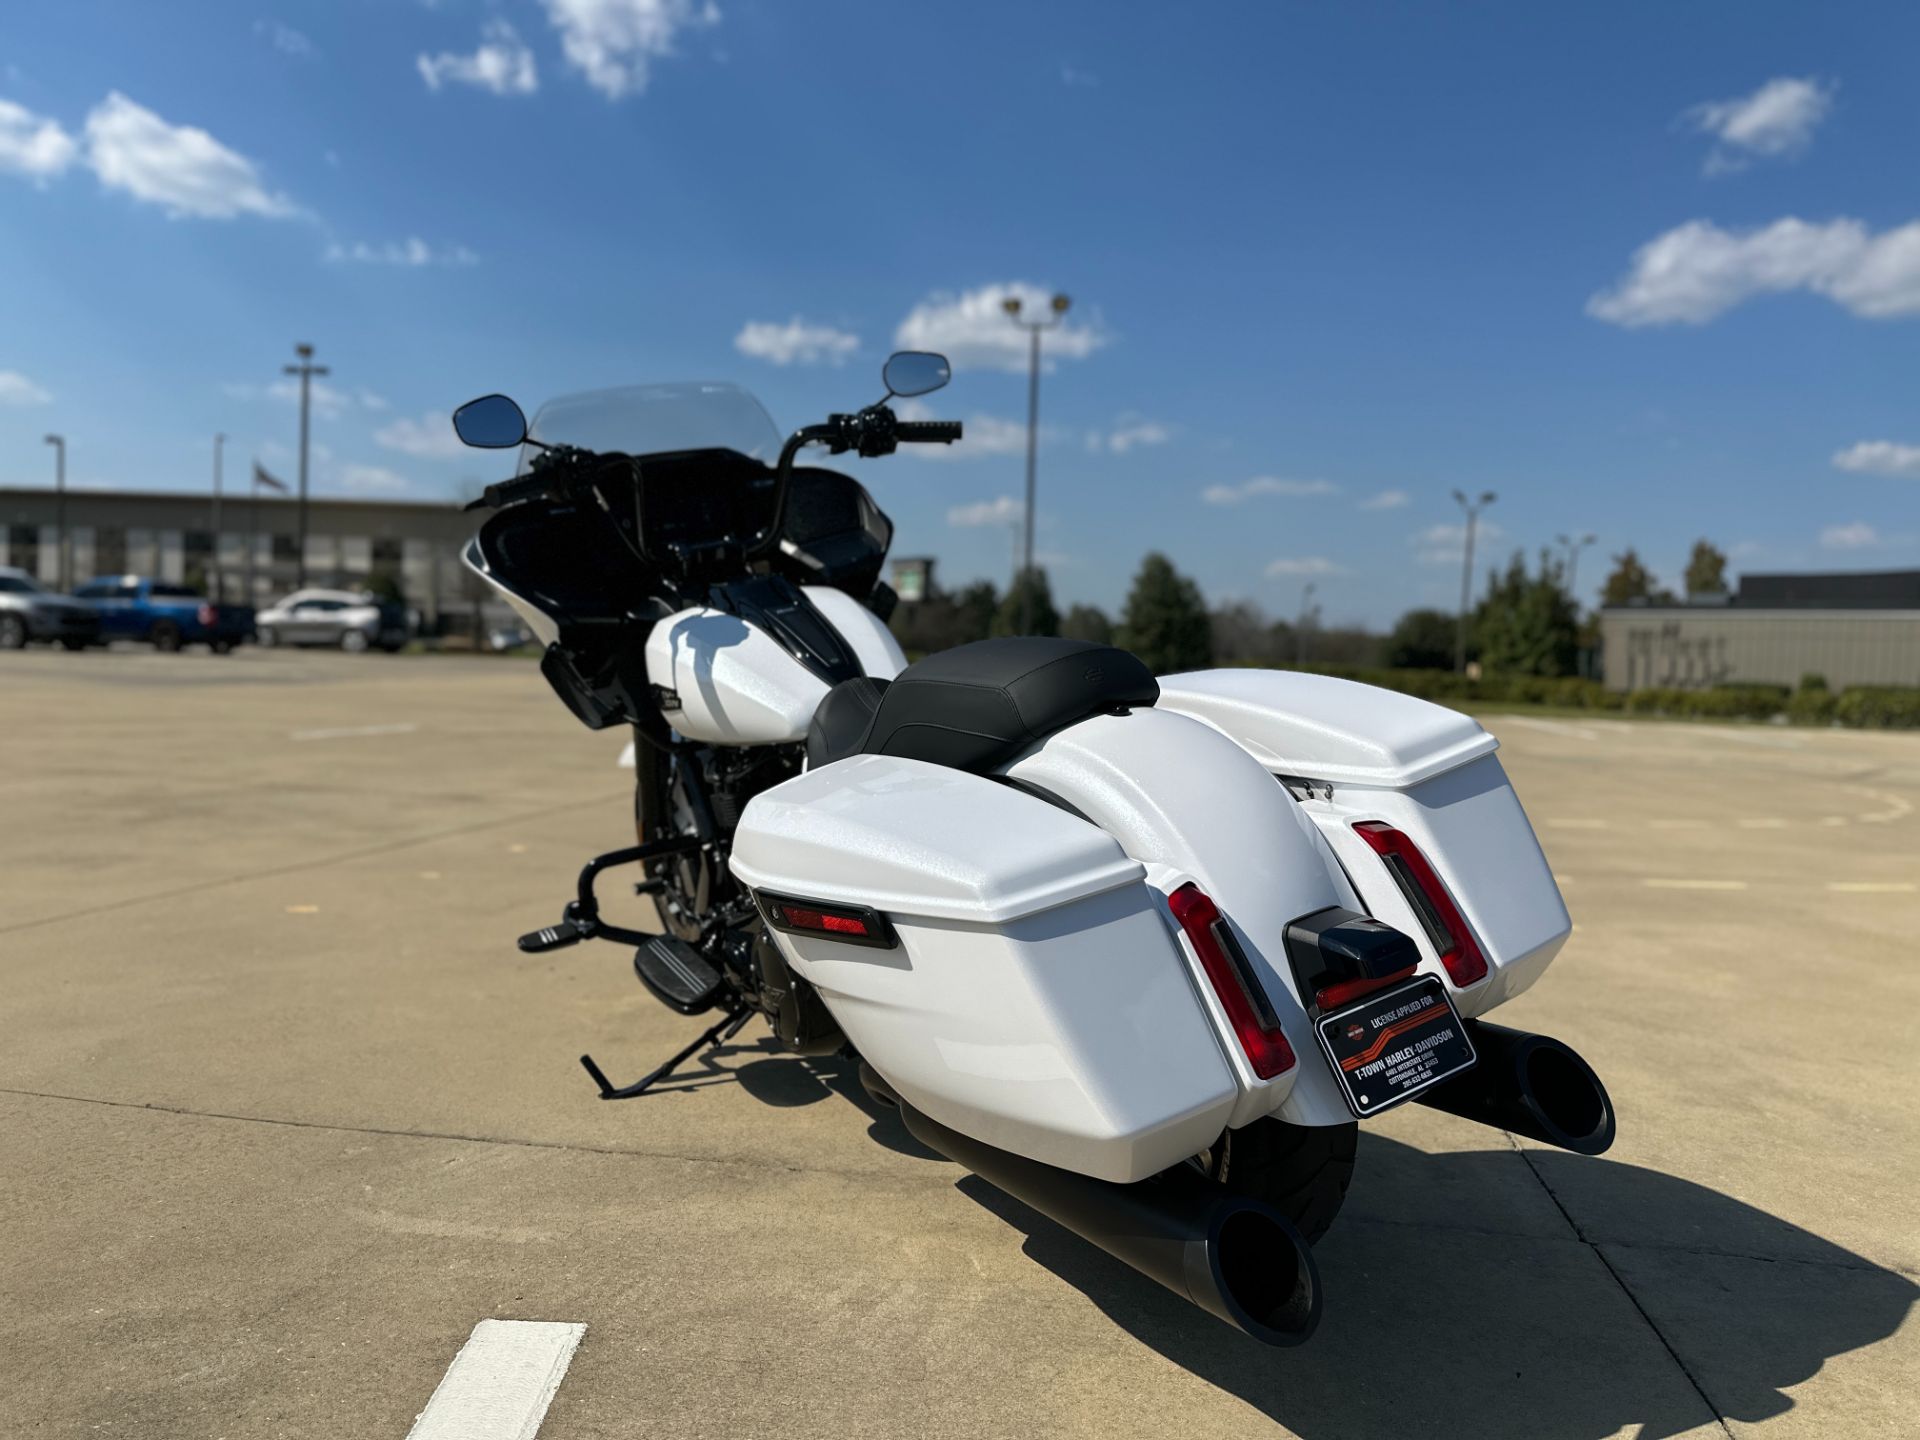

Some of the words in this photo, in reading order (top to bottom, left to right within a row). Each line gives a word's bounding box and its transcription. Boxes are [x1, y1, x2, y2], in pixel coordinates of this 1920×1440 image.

[1370, 1011, 1397, 1029] LICENSE
[1396, 1001, 1422, 1018] APPLIED
[1420, 995, 1434, 1008] FOR
[1354, 1059, 1386, 1080] T-TOWN
[1385, 1028, 1454, 1067] HARLEY-DAVIDSON
